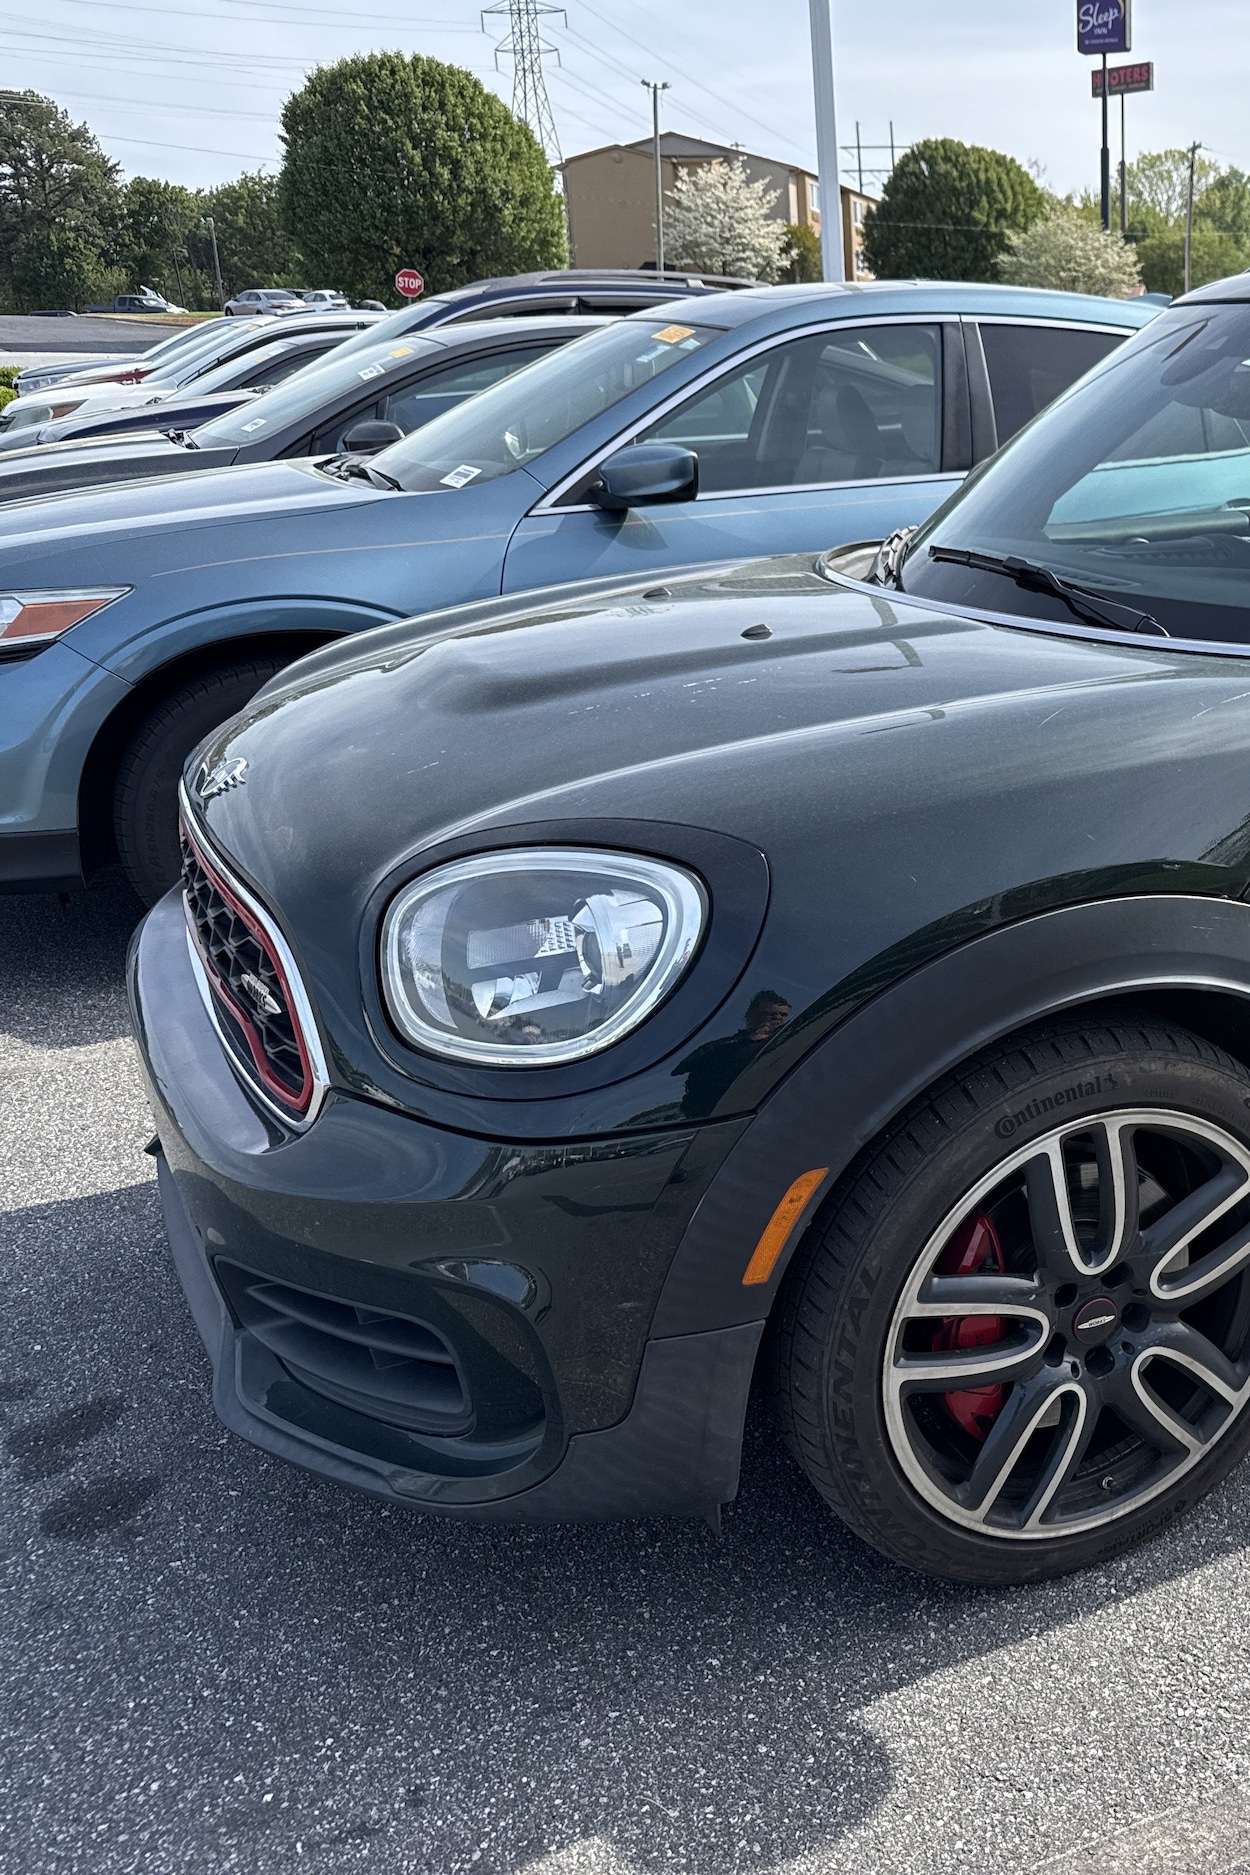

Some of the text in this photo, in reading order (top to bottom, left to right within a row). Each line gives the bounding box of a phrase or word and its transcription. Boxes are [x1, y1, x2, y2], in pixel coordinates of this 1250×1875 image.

[1079, 2, 1120, 33] Sleep
[1093, 65, 1149, 88] HOTERS
[398, 276, 422, 289] STOP
[994, 1076, 1103, 1139] Continental
